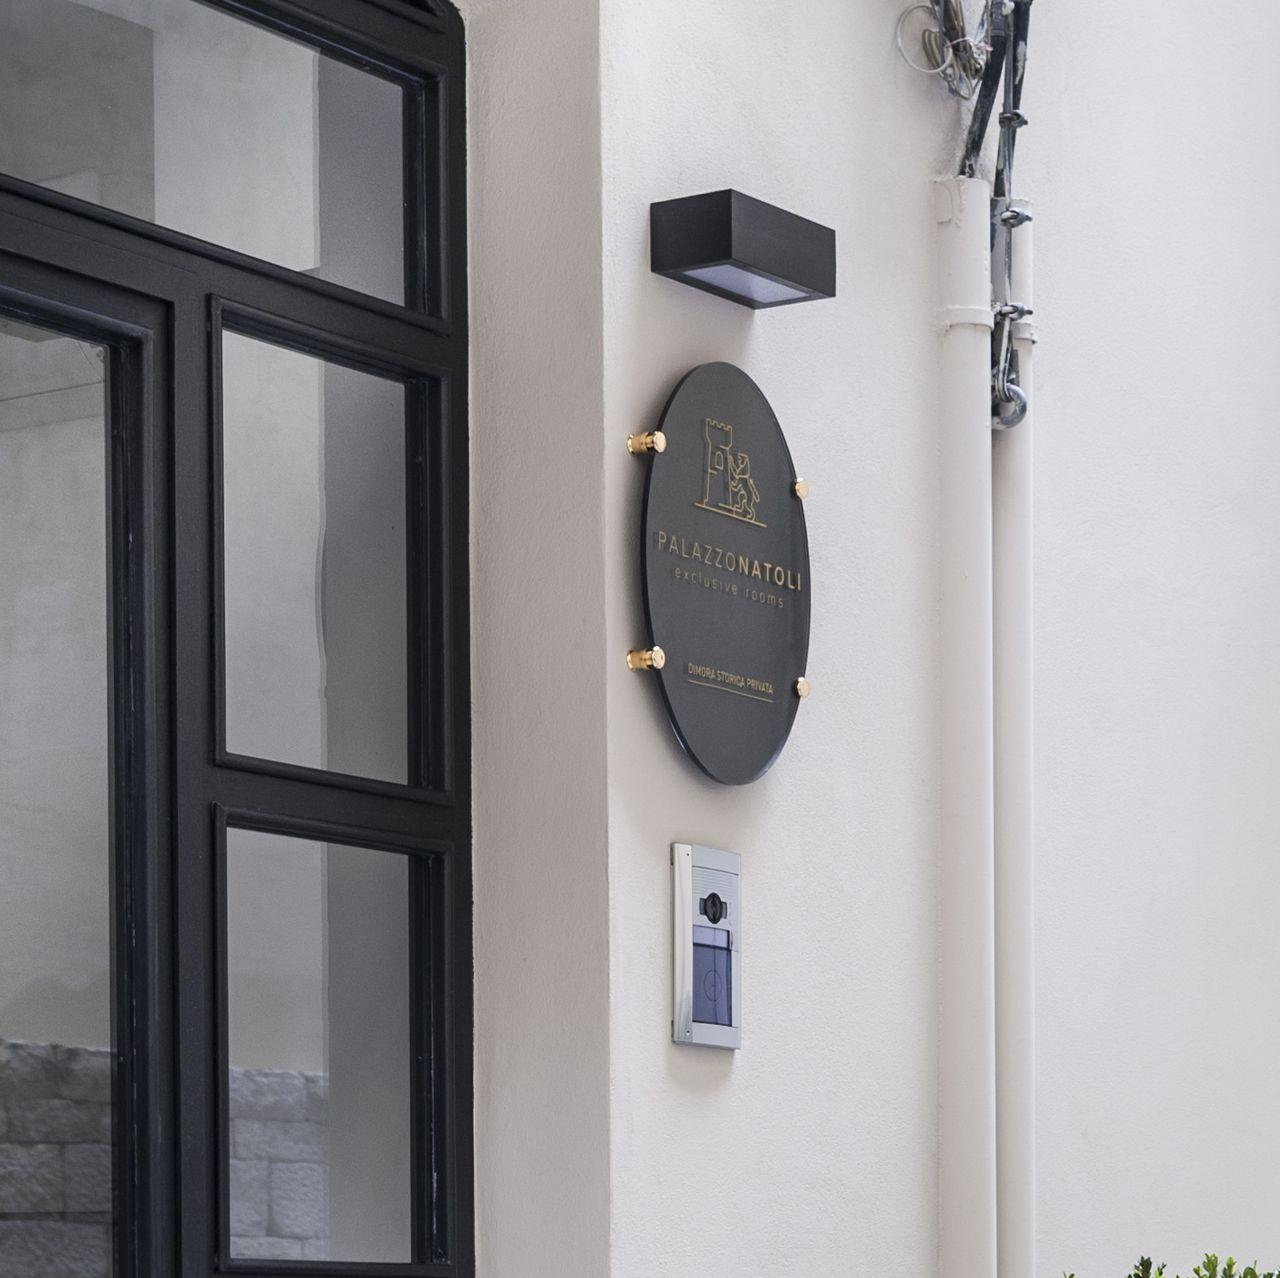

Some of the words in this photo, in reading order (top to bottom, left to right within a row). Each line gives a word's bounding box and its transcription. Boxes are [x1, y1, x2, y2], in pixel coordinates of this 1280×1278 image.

[658, 530, 801, 591] PALAZZONATOLI
[674, 566, 738, 595] exclusive
[745, 587, 784, 609] rooms
[688, 662, 716, 679] DIMORA
[717, 669, 746, 688] STORICA
[746, 678, 774, 695] PRIVATA
